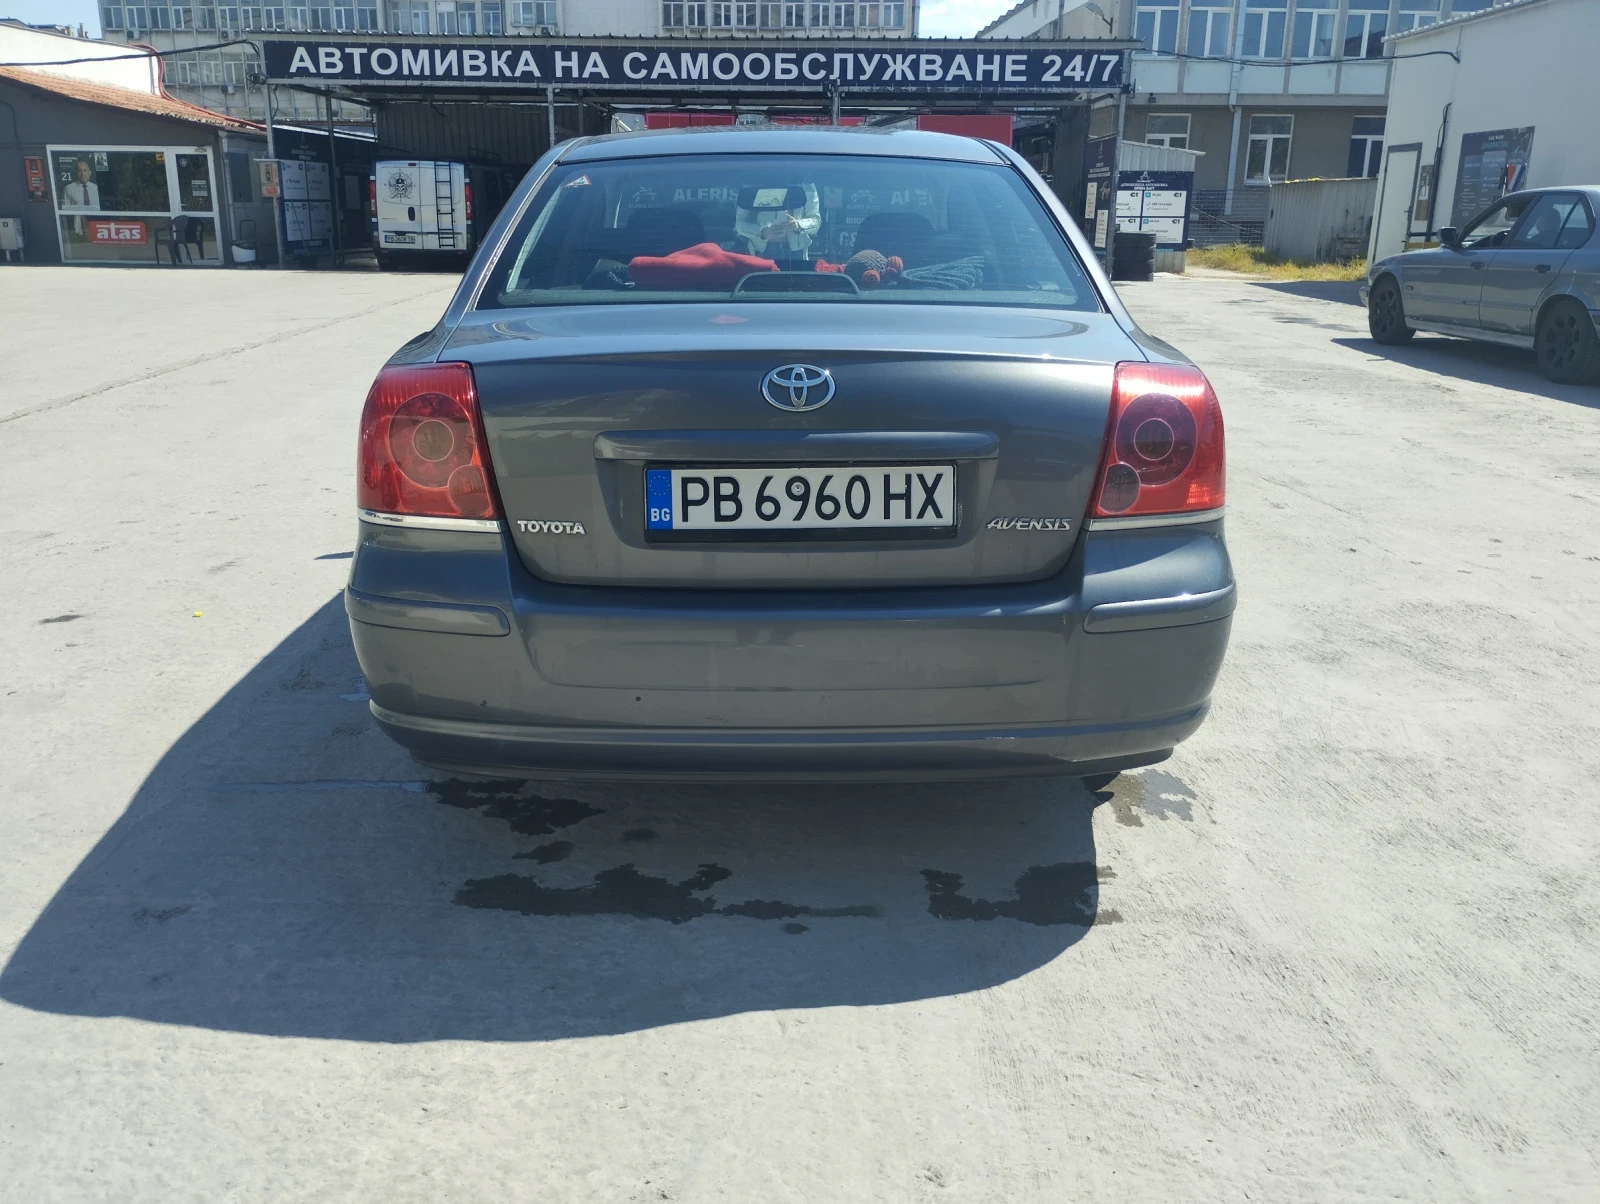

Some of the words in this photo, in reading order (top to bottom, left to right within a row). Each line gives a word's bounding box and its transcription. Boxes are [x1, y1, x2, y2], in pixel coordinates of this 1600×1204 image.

[289, 46, 541, 79] АВТОМИВКА
[554, 51, 610, 79] НА
[623, 52, 1028, 83] САМООБСЛУЖВАНЕ
[1041, 54, 1120, 83] 24/7
[61, 172, 72, 181] 21
[673, 188, 739, 200] ALERIS
[96, 222, 141, 240] atas
[680, 476, 743, 523] PB
[754, 475, 871, 522] 6960
[883, 473, 944, 520] HX
[650, 507, 671, 522] BG
[517, 520, 586, 535] TOYOTA
[986, 517, 1072, 531] AVENSIS
